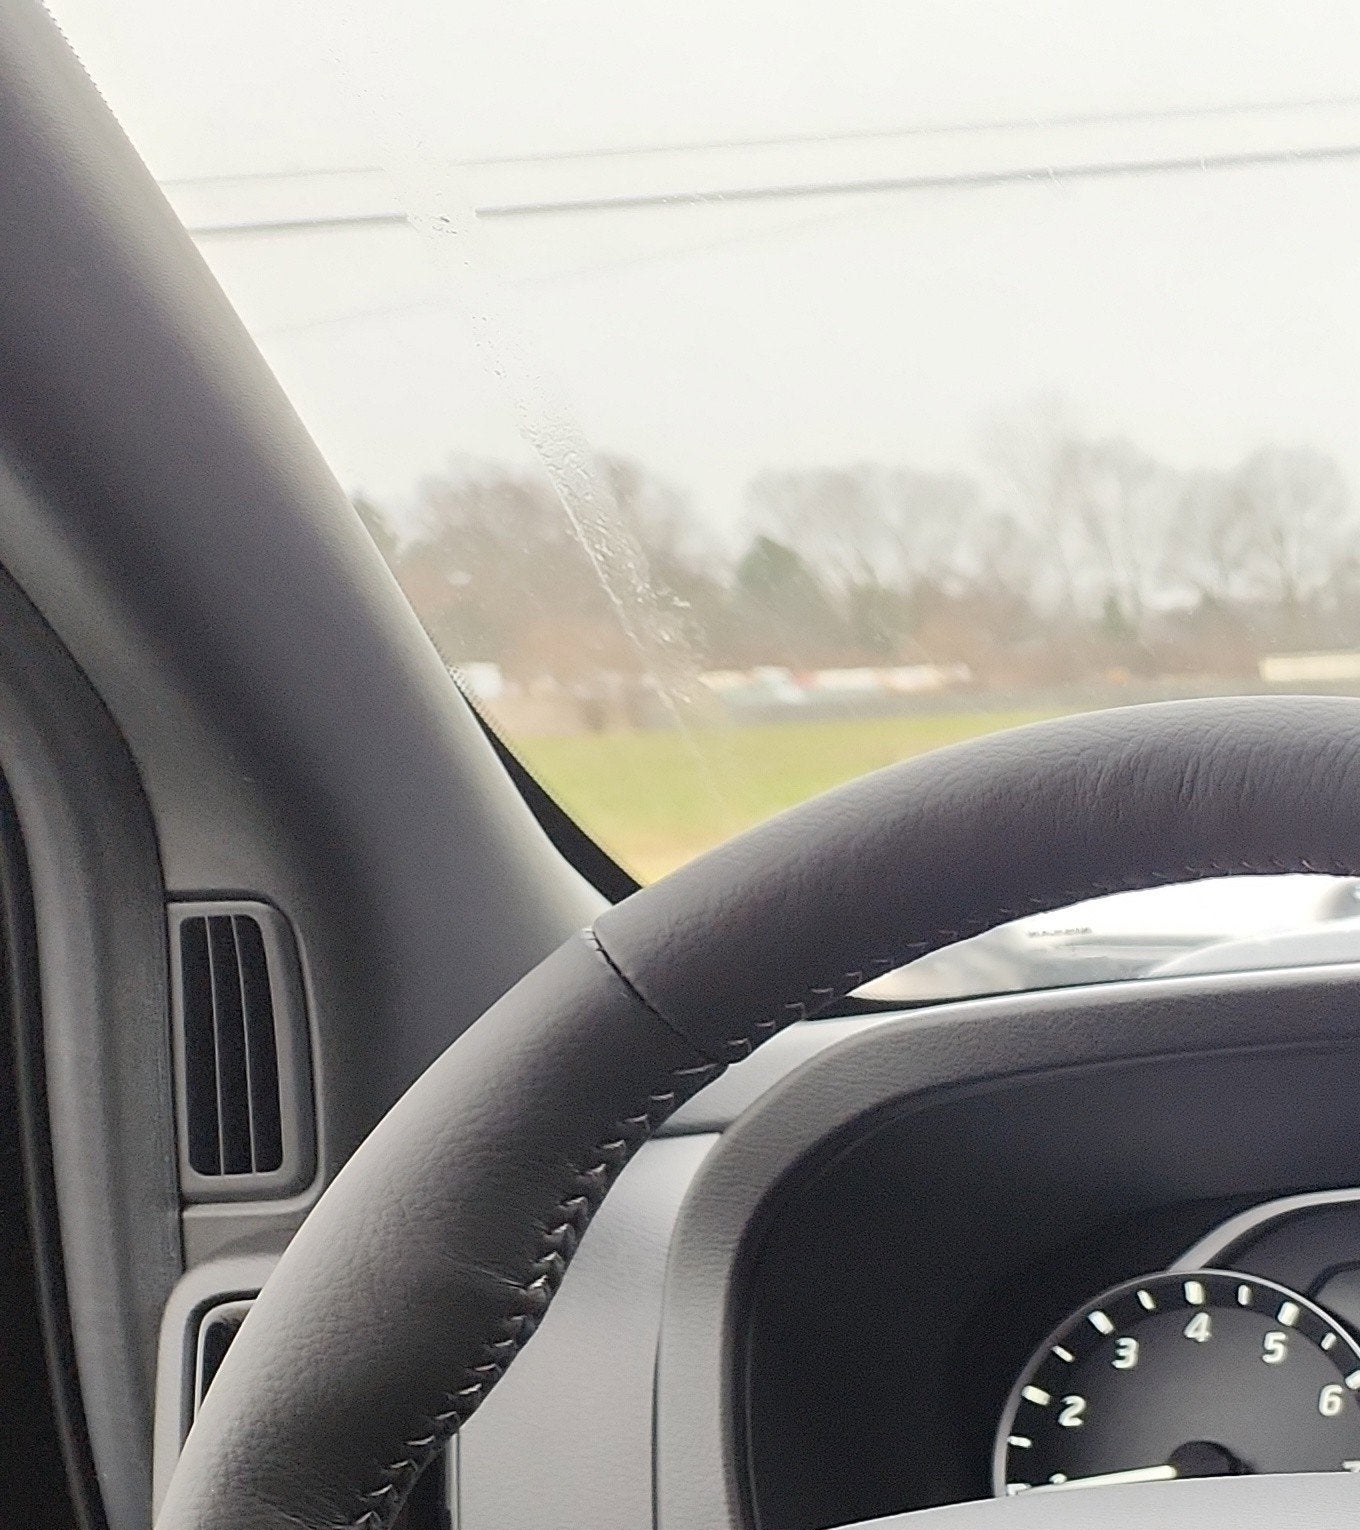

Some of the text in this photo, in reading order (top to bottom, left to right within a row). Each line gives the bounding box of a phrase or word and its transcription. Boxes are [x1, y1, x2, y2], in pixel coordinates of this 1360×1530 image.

[1184, 1312, 1212, 1343] 4
[1111, 1337, 1139, 1369] 3
[1262, 1332, 1288, 1364] 5
[1058, 1396, 1086, 1427] 2
[1319, 1384, 1343, 1417] 6
